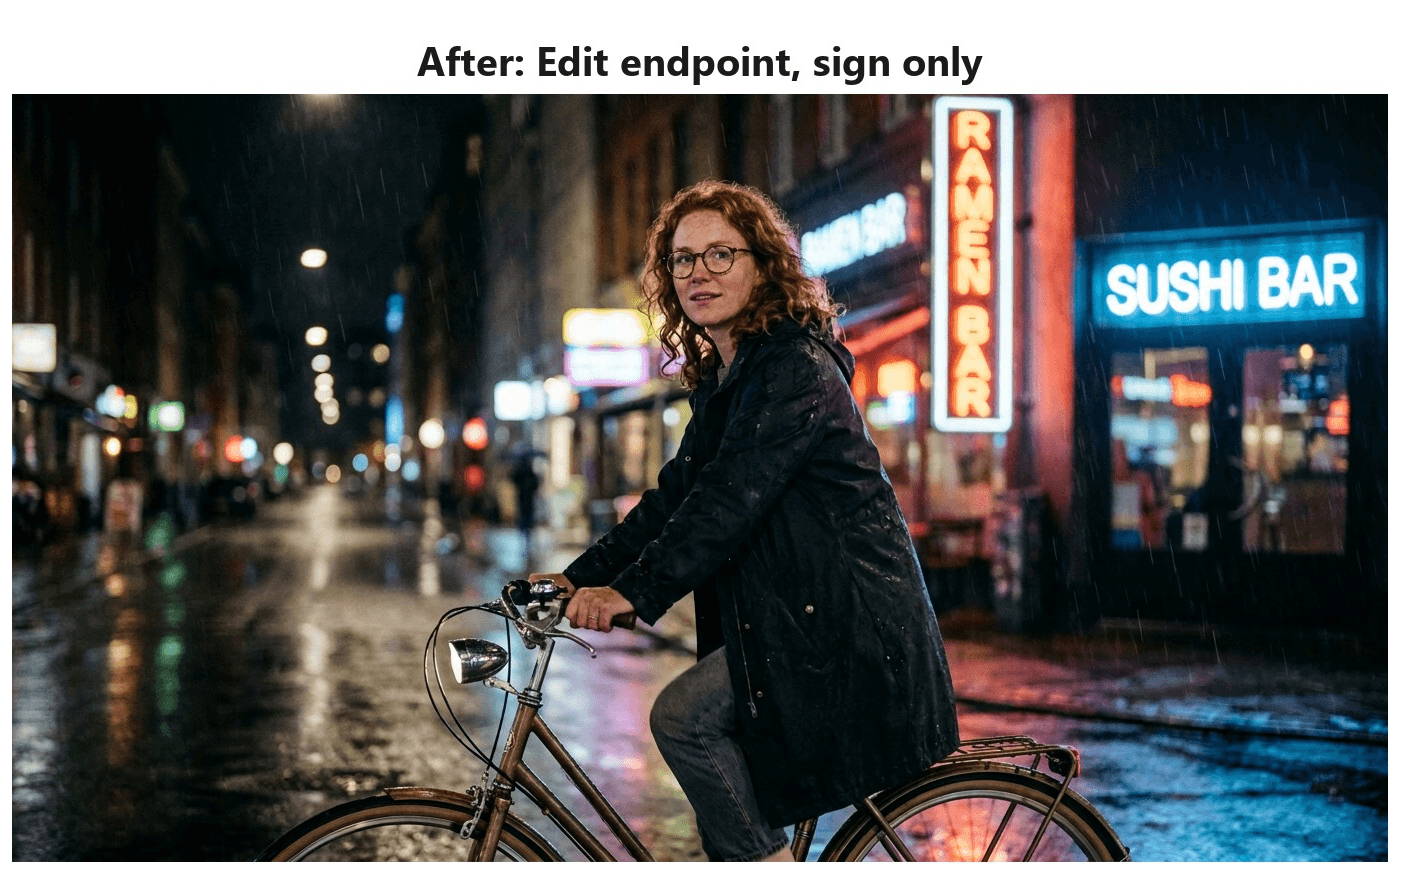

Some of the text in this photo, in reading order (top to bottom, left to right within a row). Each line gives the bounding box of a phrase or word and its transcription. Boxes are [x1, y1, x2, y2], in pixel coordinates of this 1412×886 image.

[952, 109, 994, 419] RAMEN BAR
[1105, 252, 1359, 317] SUSHI BAR
